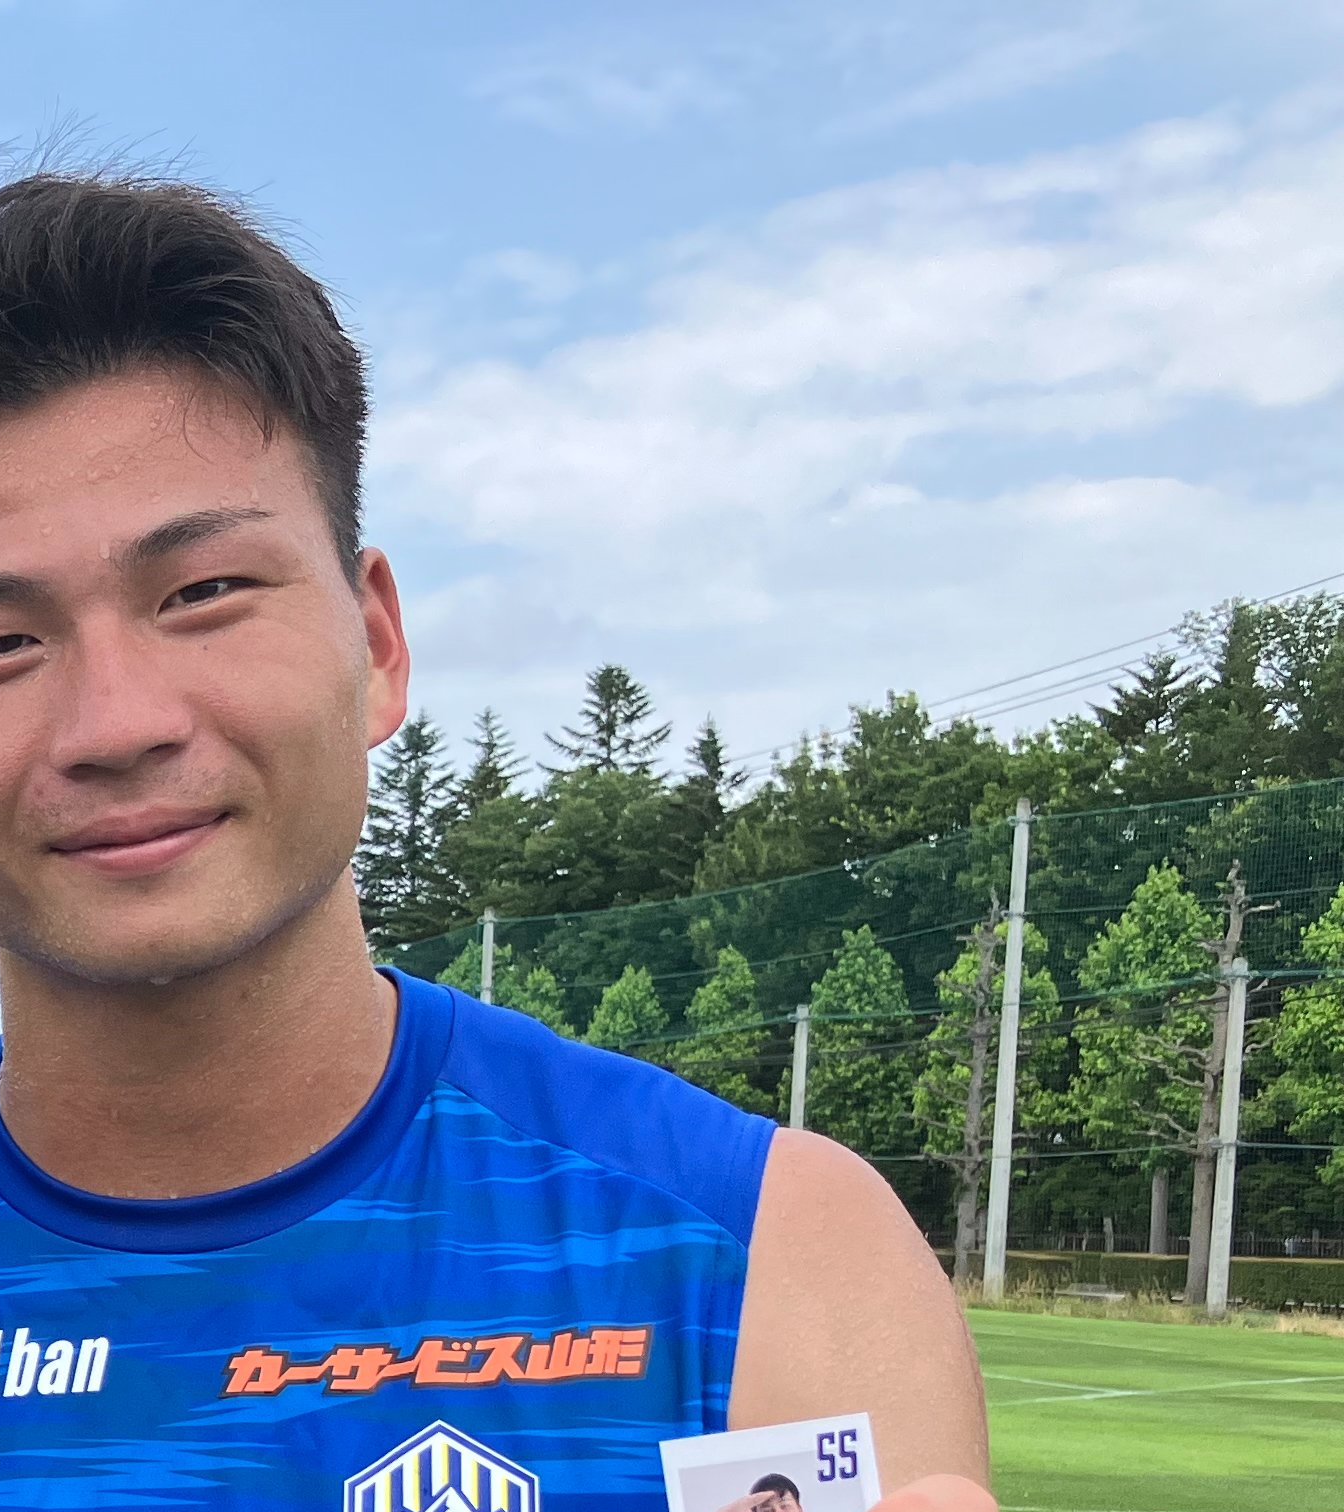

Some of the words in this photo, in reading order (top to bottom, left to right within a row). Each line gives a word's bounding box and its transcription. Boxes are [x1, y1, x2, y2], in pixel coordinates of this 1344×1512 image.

[224, 1328, 648, 1395] カーサービス山形
[816, 1428, 858, 1482] 55
